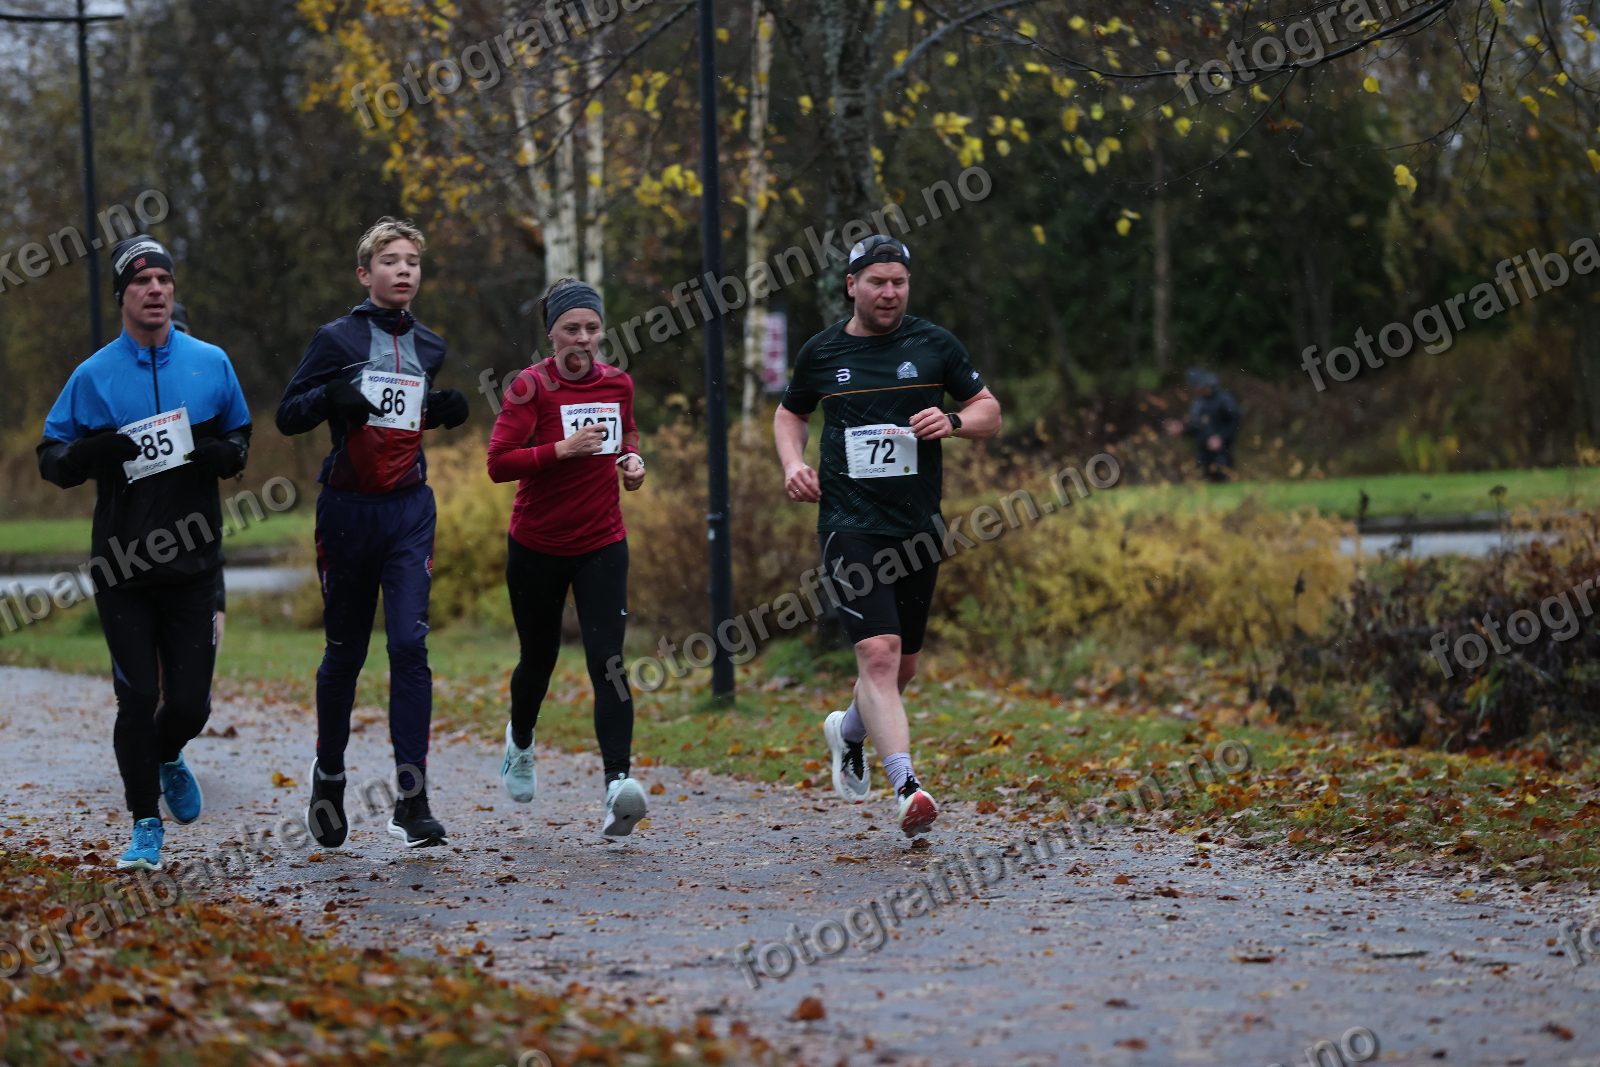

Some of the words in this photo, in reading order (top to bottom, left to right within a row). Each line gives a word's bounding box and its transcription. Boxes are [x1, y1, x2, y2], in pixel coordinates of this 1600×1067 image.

[380, 387, 406, 416] 86
[141, 429, 174, 460] 85
[866, 438, 896, 465] 72
